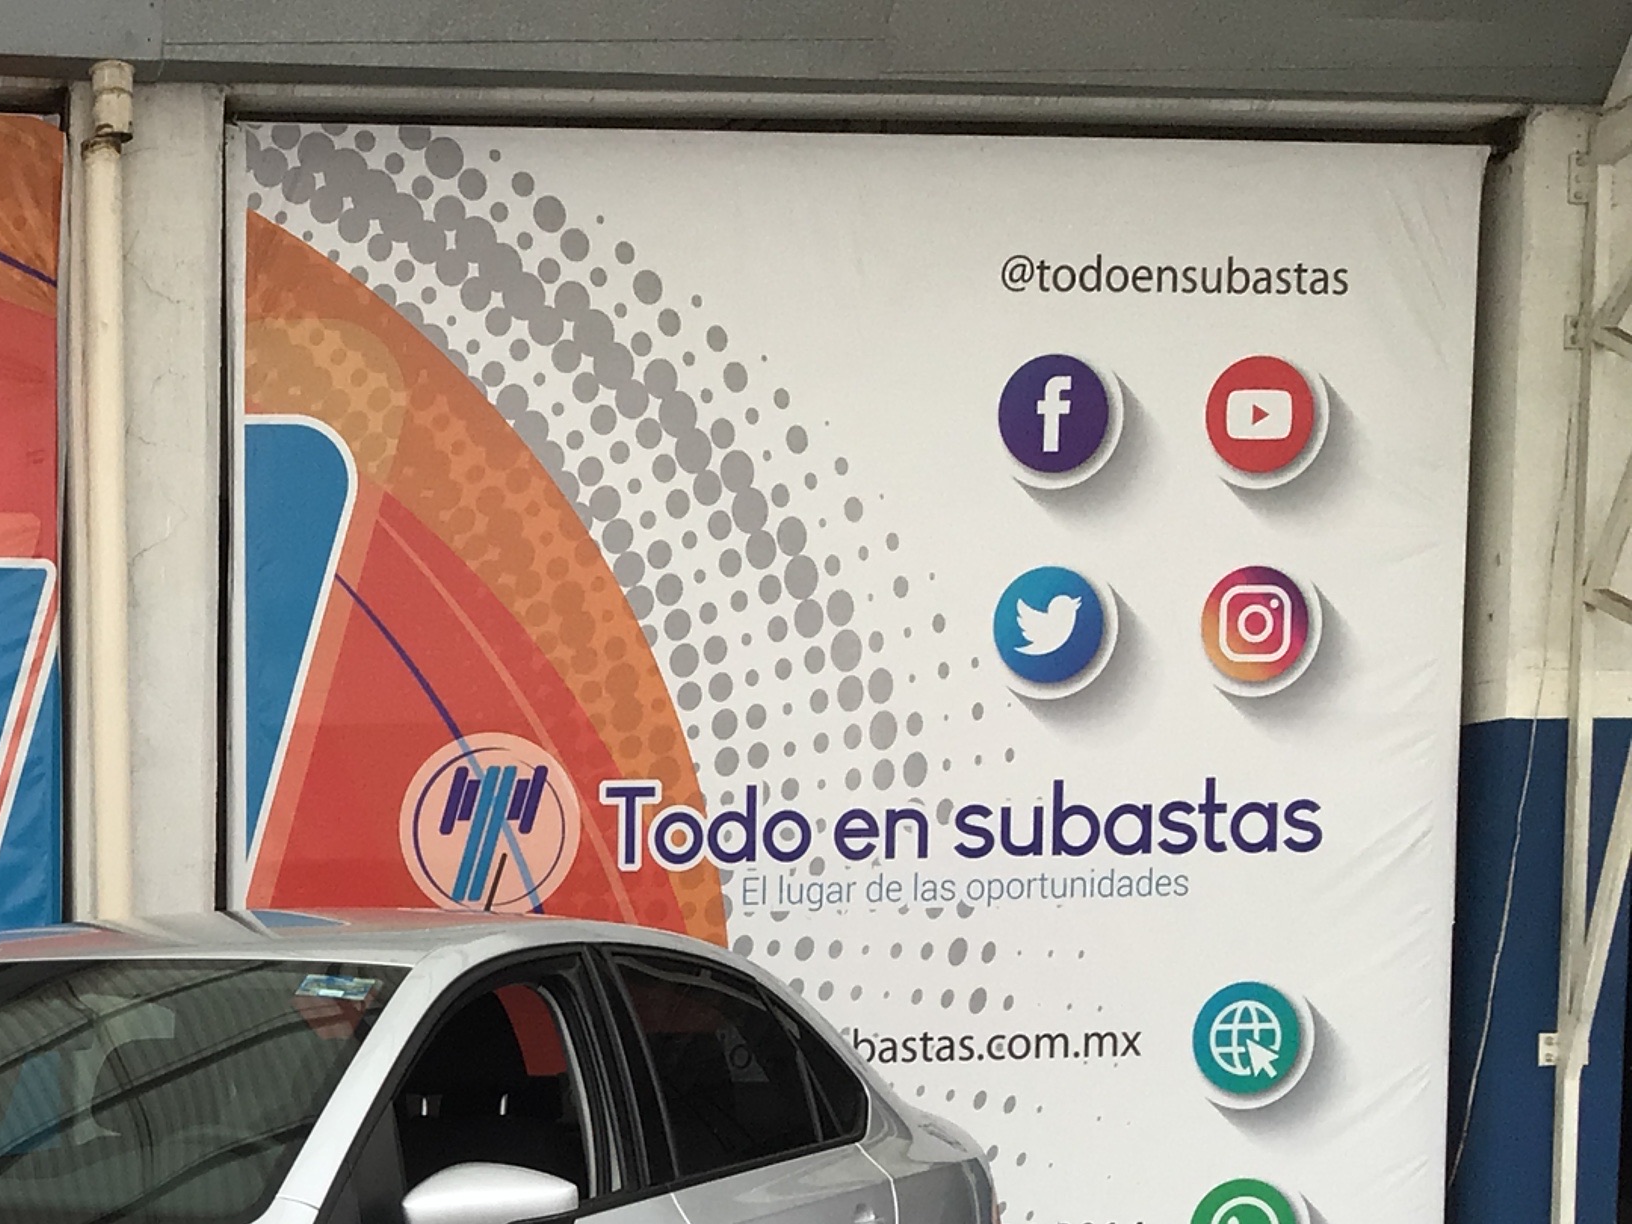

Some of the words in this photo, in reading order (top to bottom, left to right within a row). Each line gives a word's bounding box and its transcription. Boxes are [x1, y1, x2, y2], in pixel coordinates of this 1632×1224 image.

[1001, 253, 1349, 296] @todoensubastas
[604, 783, 813, 866] Todo
[833, 807, 929, 862] en
[953, 777, 1324, 859] subastas
[742, 875, 768, 906] El
[777, 873, 858, 912] lugar
[865, 873, 904, 903] de
[912, 872, 957, 902] las
[966, 868, 1190, 907] oportunidades
